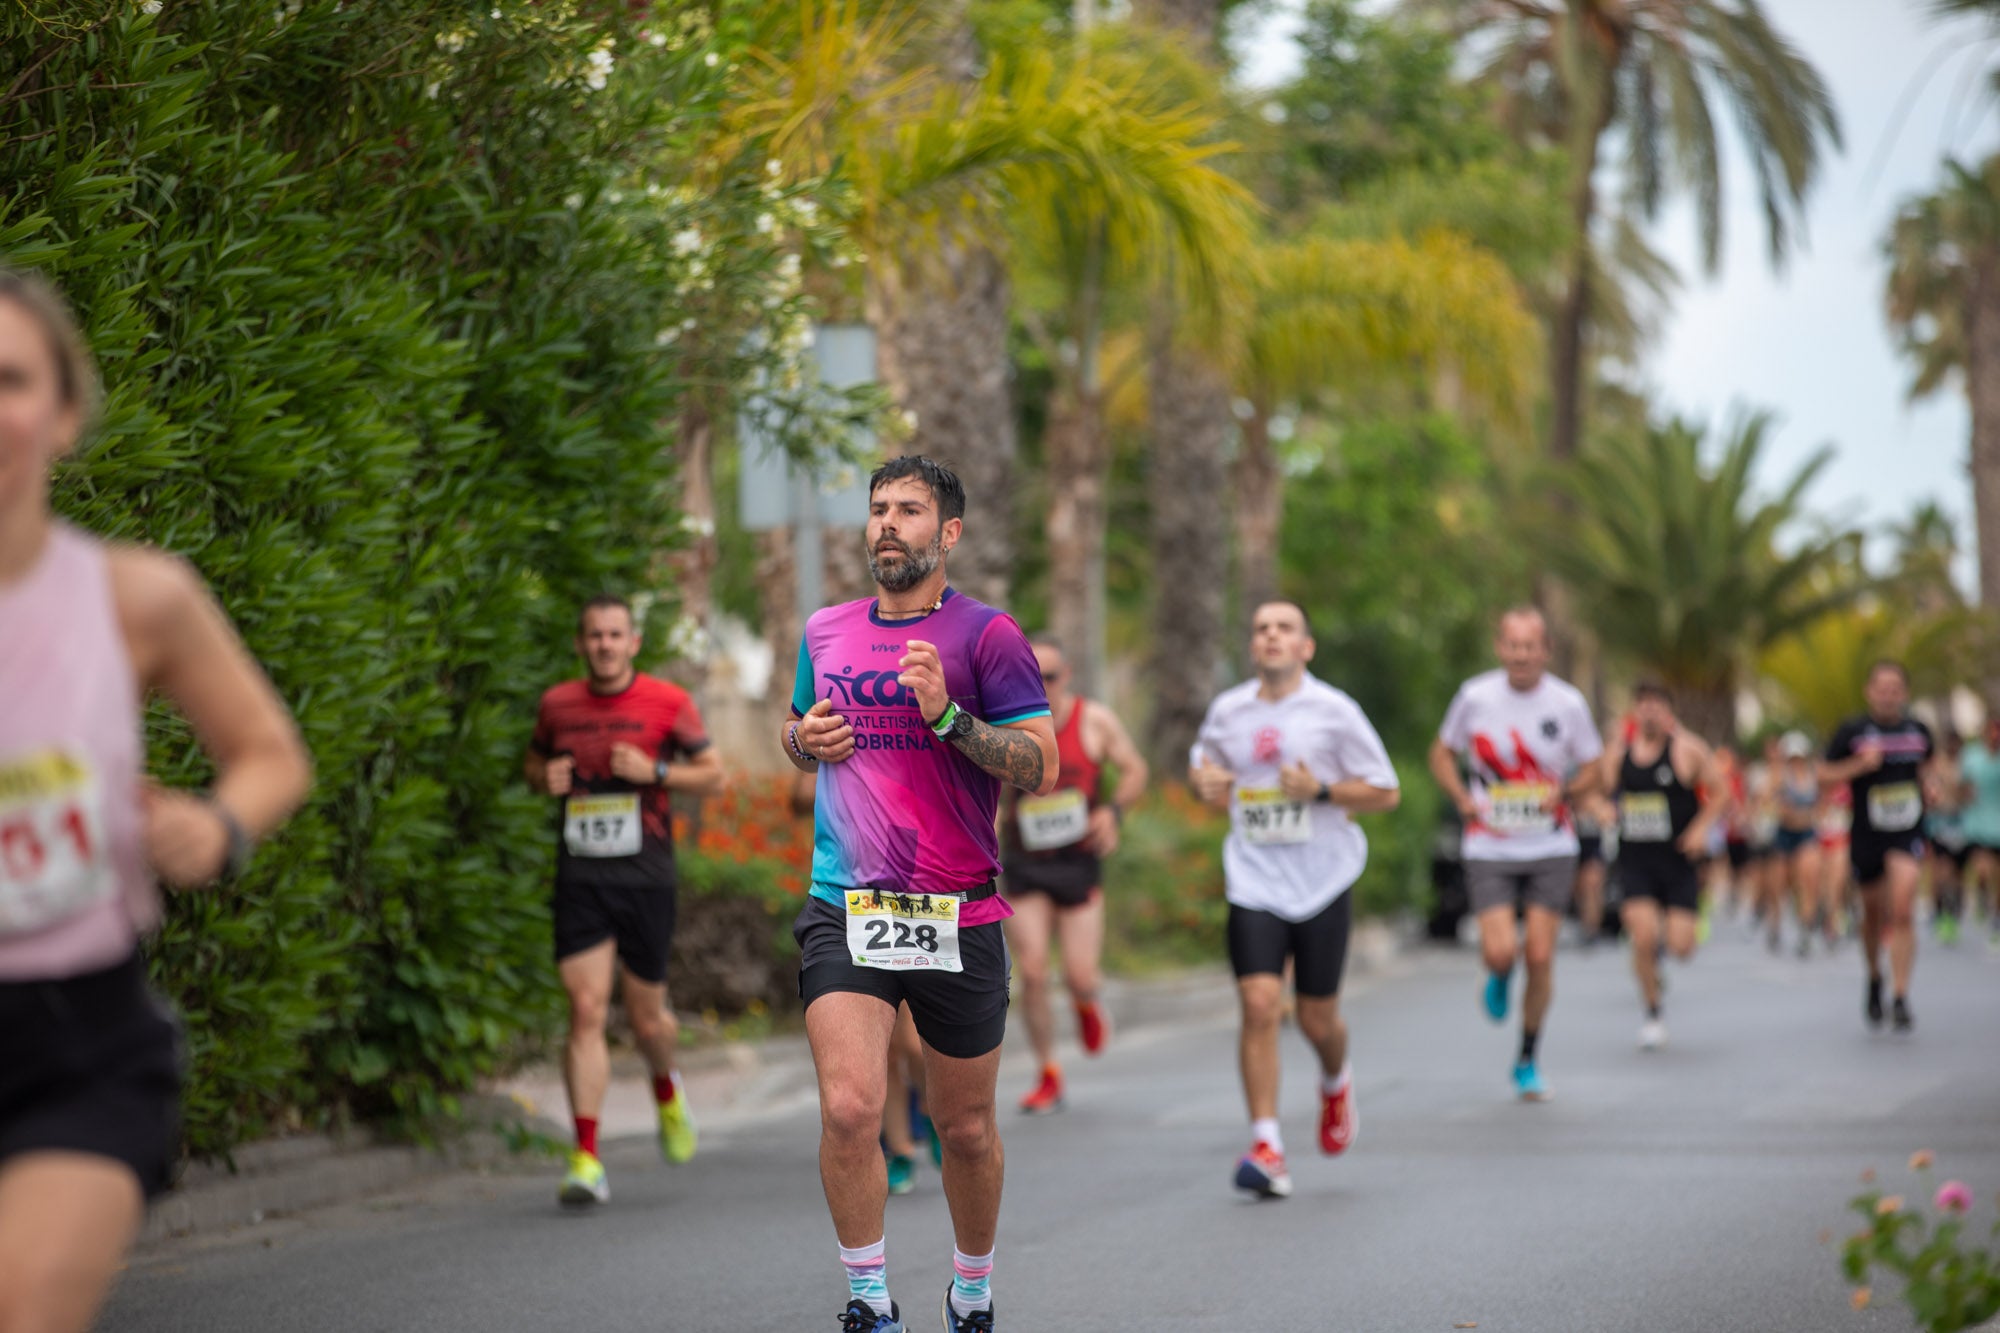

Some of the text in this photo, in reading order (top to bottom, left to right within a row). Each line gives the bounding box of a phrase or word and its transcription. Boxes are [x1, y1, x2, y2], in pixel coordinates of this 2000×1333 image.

[871, 643, 901, 653] vive
[854, 729, 934, 751] OBREÑA
[577, 816, 625, 843] 157
[864, 919, 939, 953] 228
